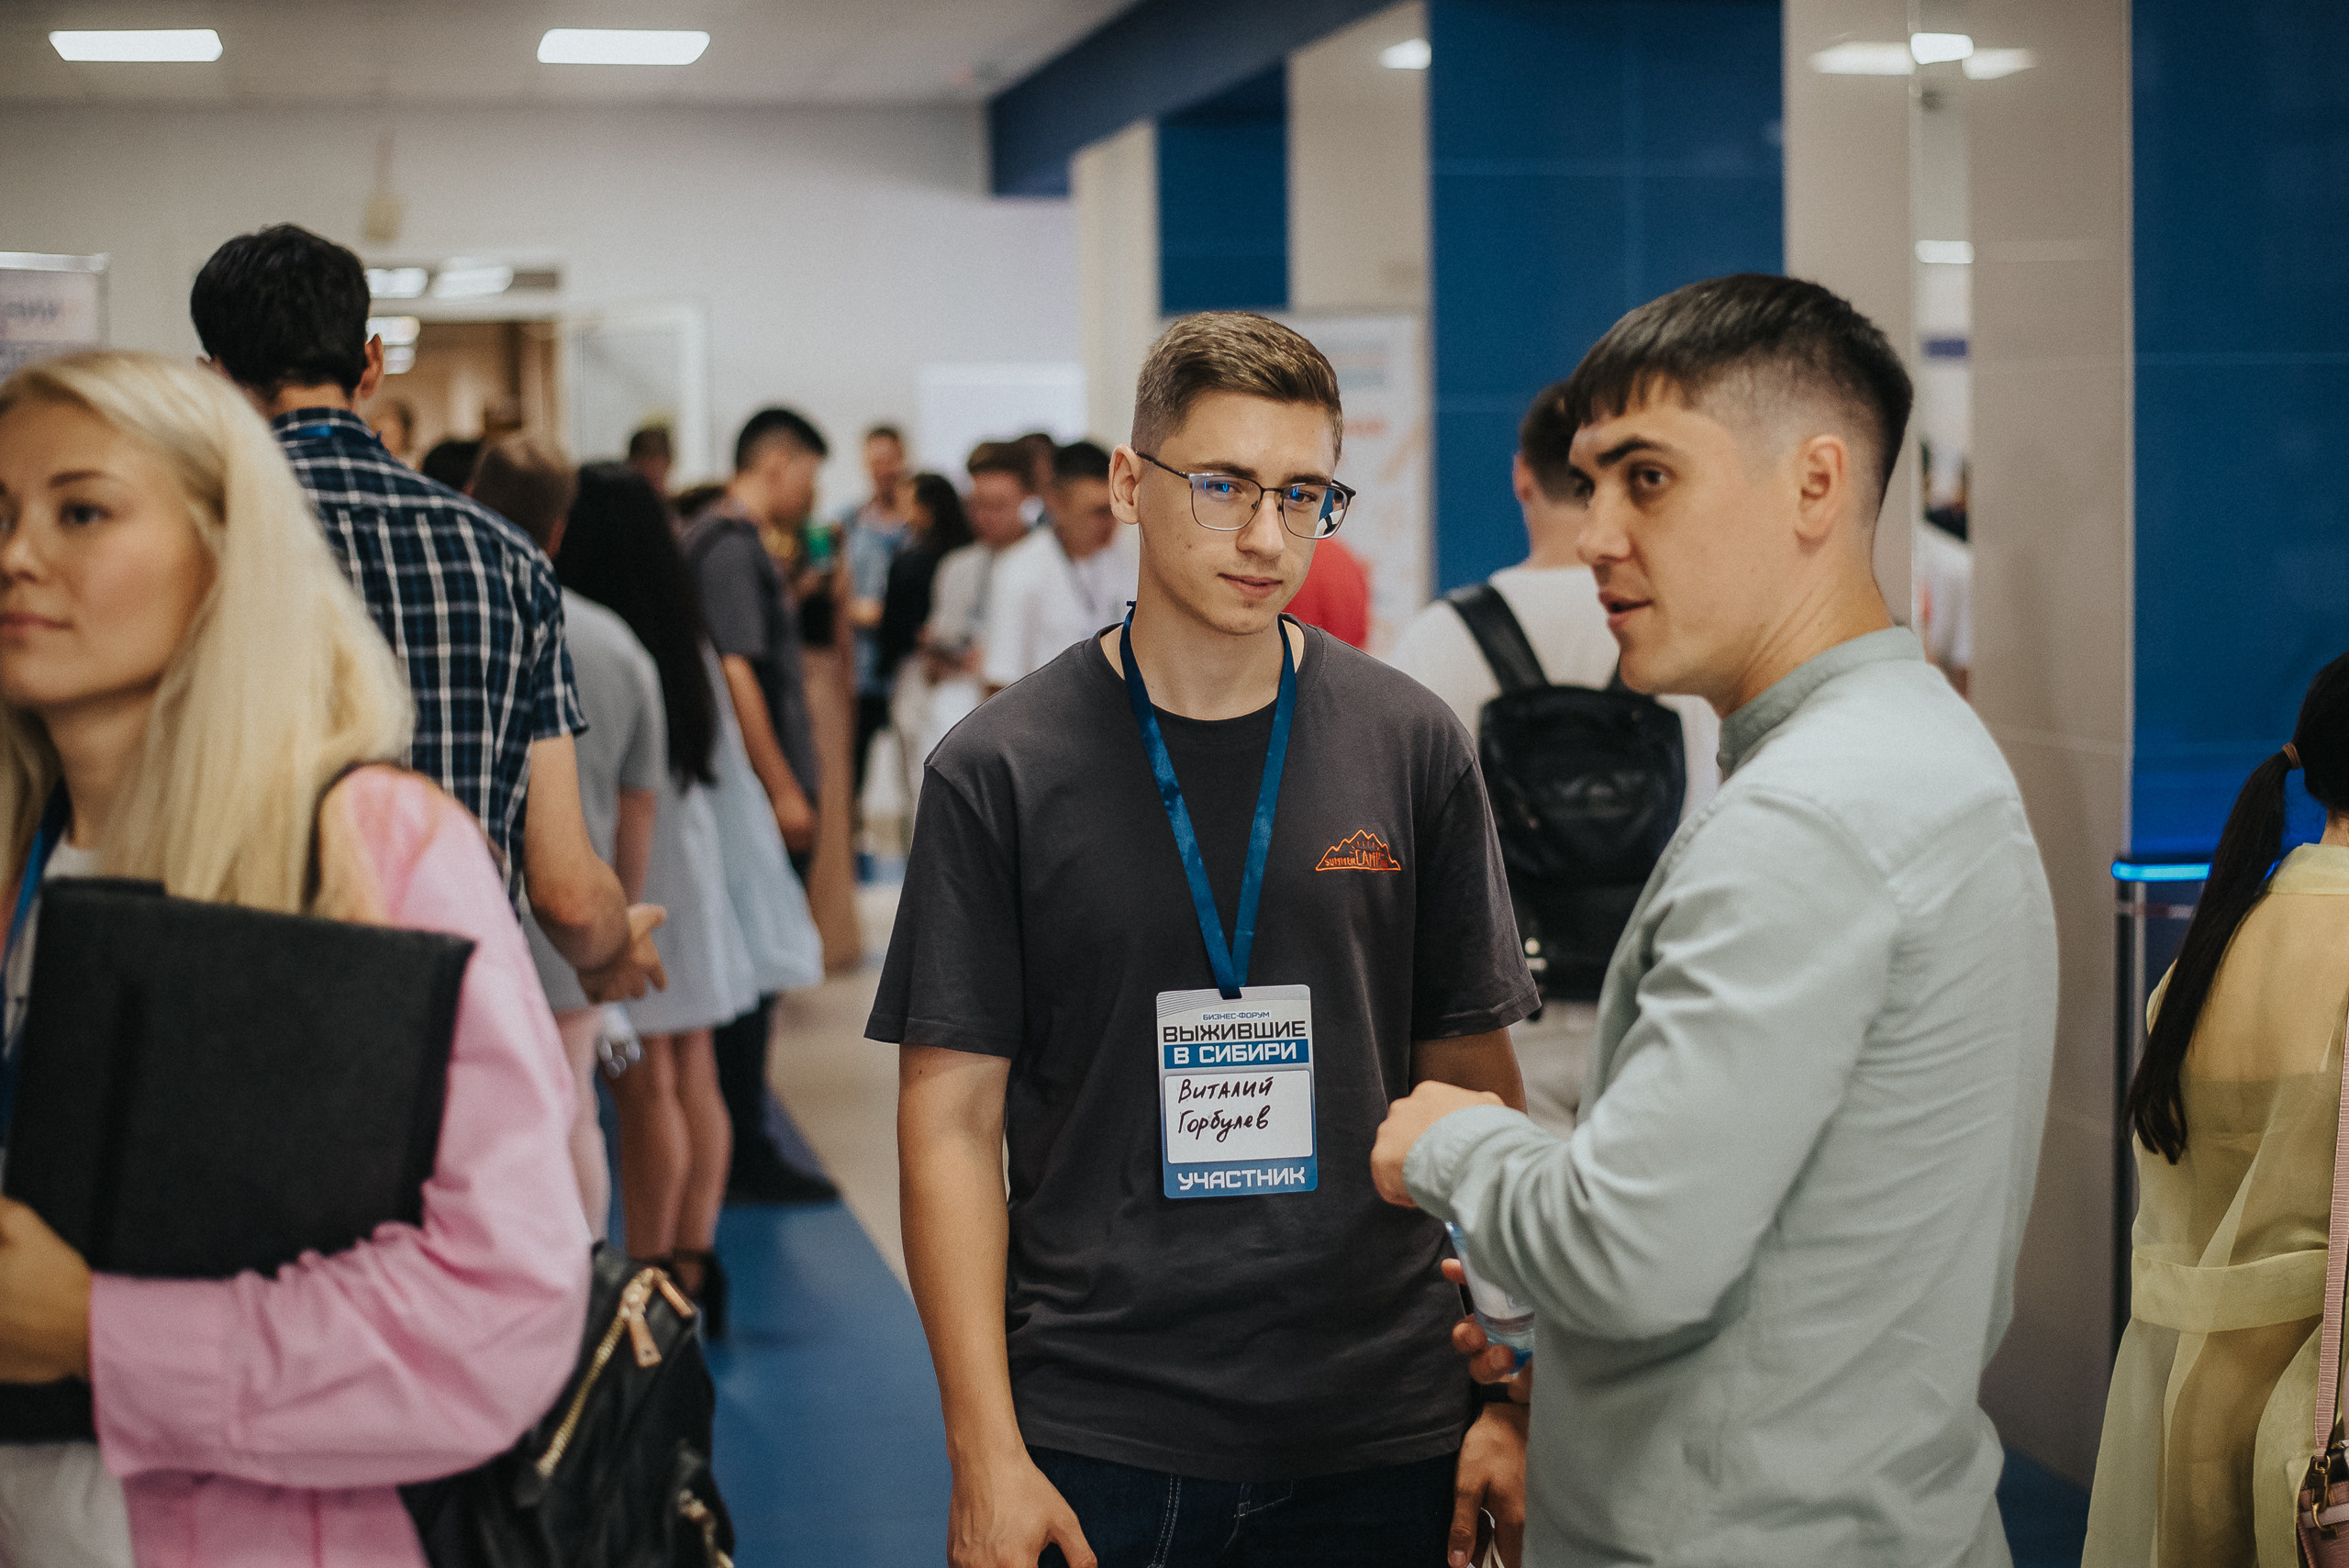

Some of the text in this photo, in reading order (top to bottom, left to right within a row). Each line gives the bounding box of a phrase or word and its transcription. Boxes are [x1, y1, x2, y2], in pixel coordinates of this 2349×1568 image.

[1324, 856, 1355, 866] SUMMER
[1355, 849, 1380, 867] CAMP
[1202, 1011, 1270, 1020] БИЗНЕС-ФОРУМ
[1163, 1020, 1306, 1042] ВЫЖИВШИЕ
[1174, 1042, 1297, 1064] В СИБИРИ
[1178, 1105, 1271, 1143] Горбулев
[1177, 1166, 1306, 1191] УЧАСТНИК
